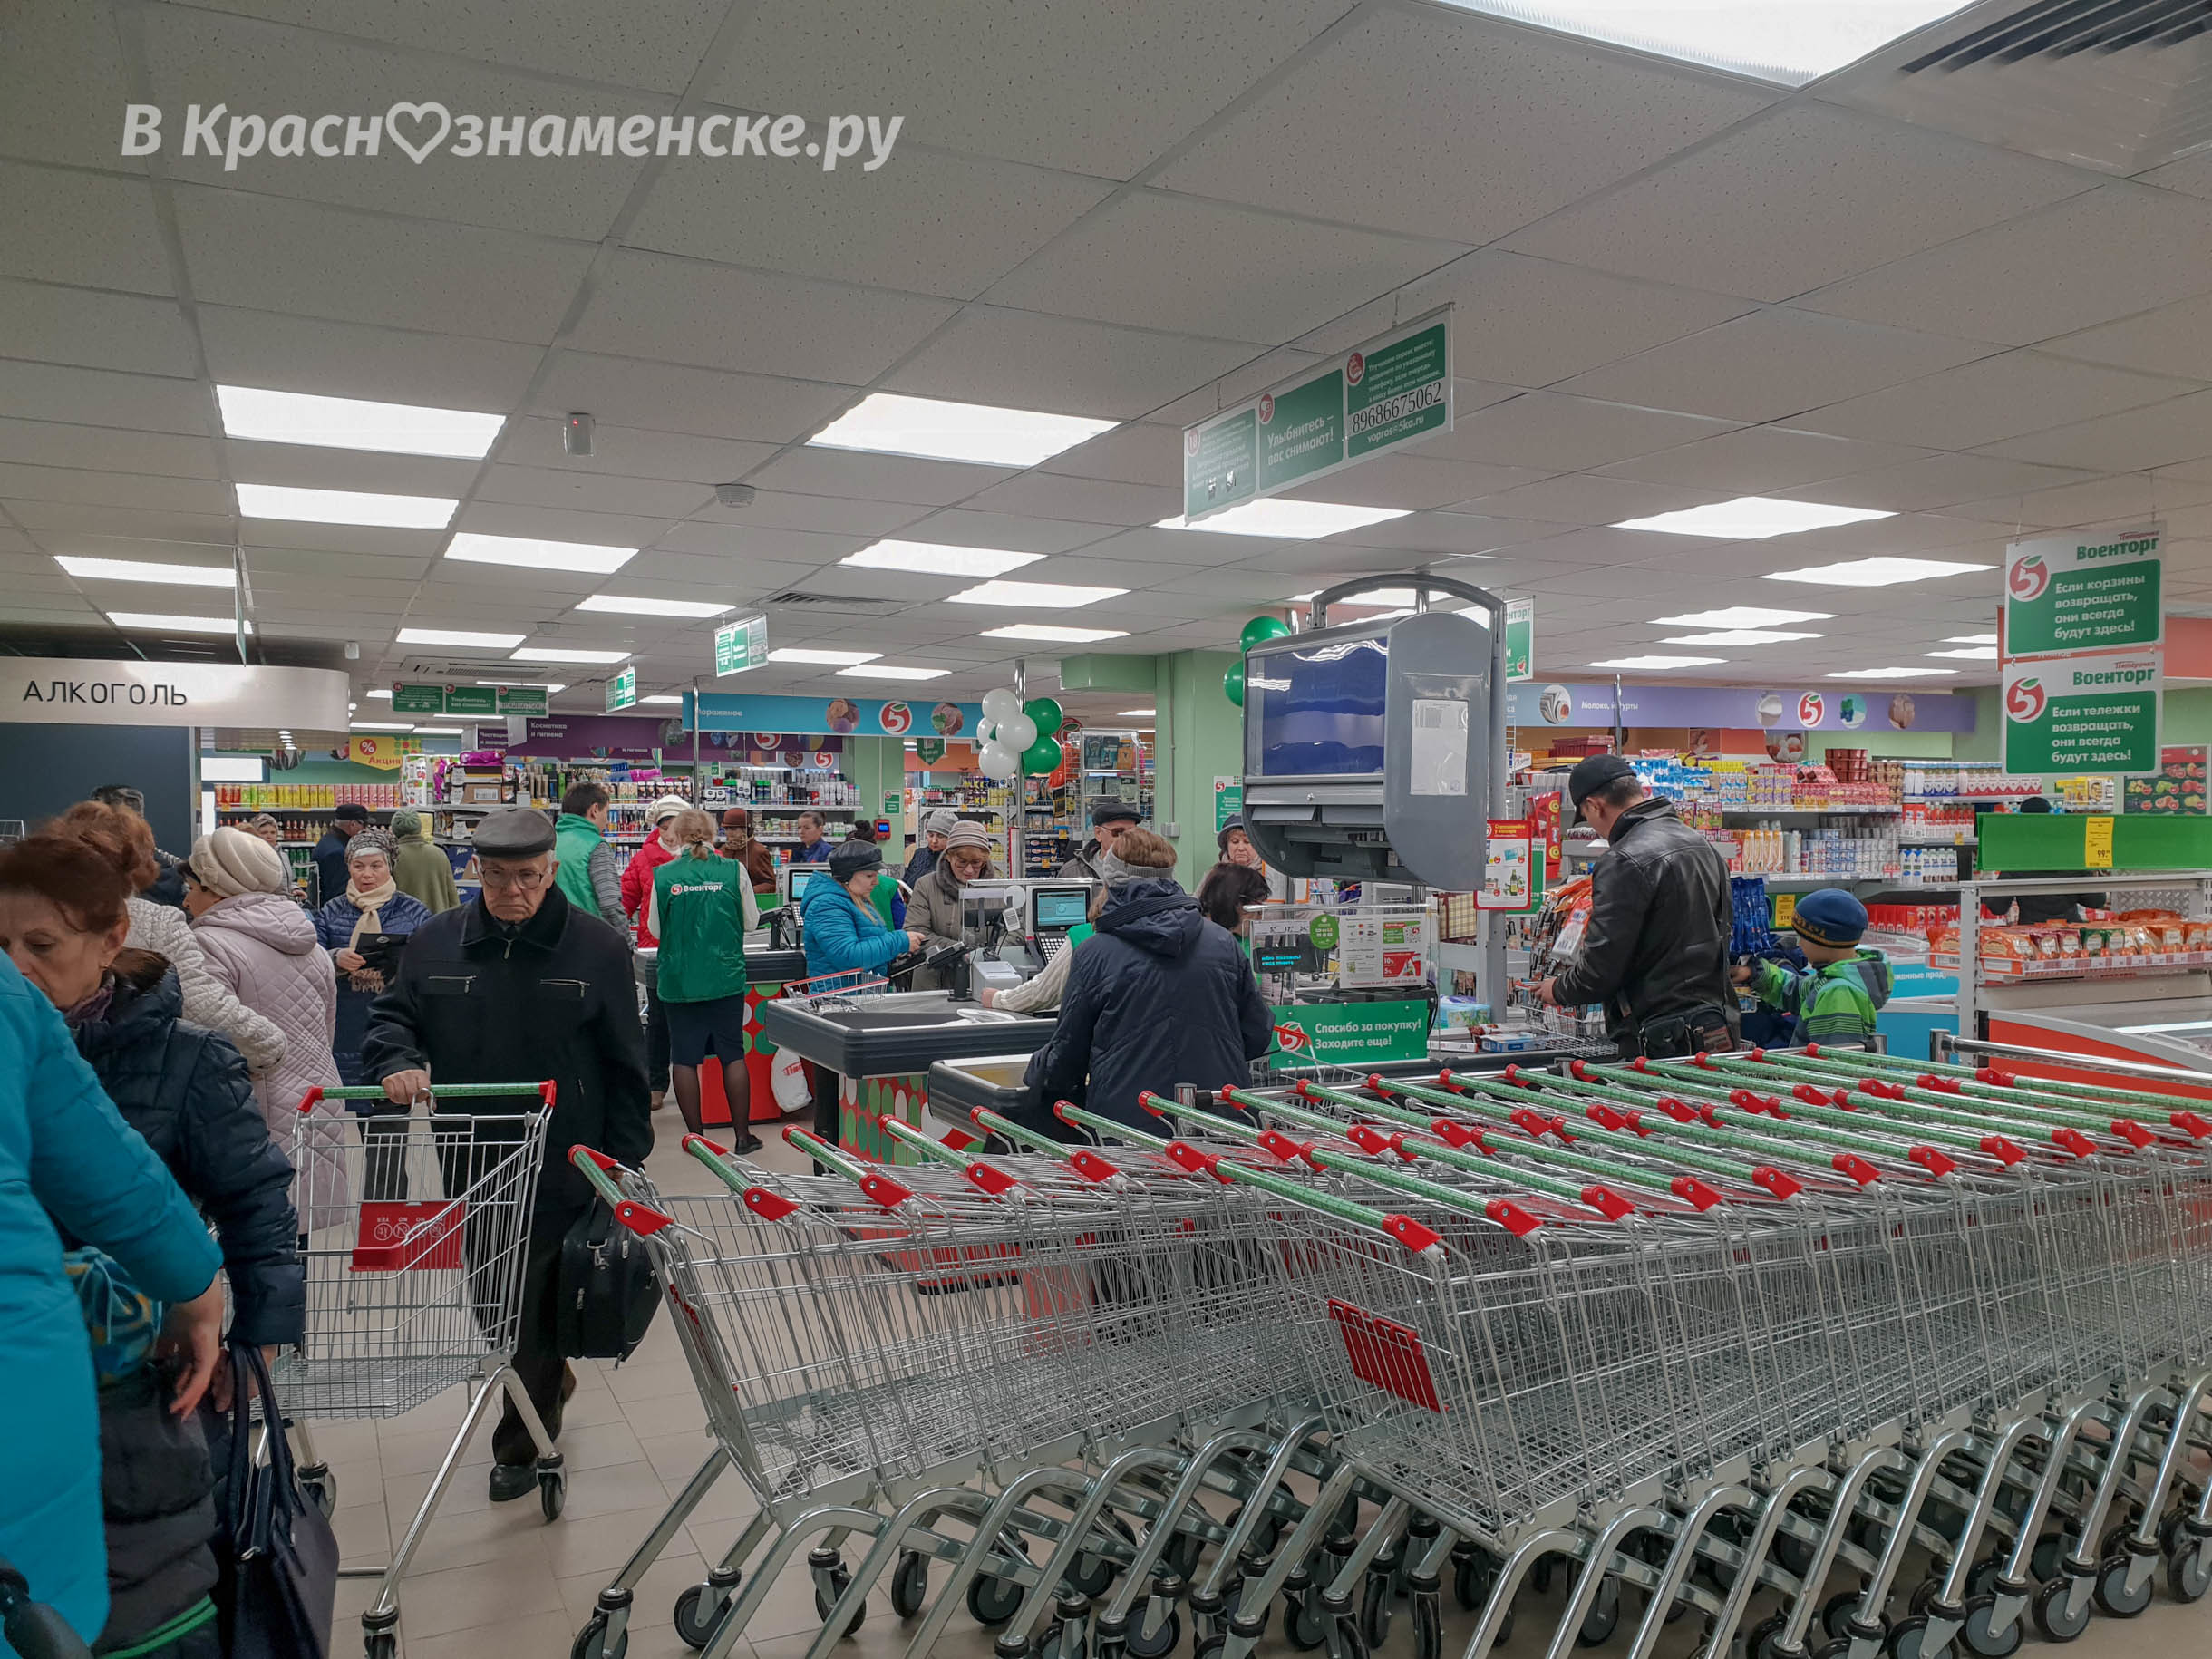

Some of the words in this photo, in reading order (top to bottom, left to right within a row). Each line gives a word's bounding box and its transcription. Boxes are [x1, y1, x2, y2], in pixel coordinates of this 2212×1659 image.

[1353, 381, 1441, 433] 89686675062
[1268, 417, 1324, 449] Улыбнитесь
[1268, 450, 1284, 466] вас
[1285, 426, 1334, 459] снимают!
[2077, 537, 2159, 560] Военторг
[2055, 581, 2083, 594] Если
[2087, 574, 2145, 592] корзины
[2054, 594, 2138, 609] возвращать,
[2054, 612, 2079, 625] они
[2081, 607, 2124, 623] всегда
[2054, 625, 2091, 640] будут
[2095, 620, 2135, 636] здесь!
[2073, 668, 2155, 685] Военторг
[23, 680, 188, 706] АЛКОГОЛЬ
[2052, 706, 2081, 718] Если
[2083, 704, 2140, 716] тележки
[2052, 721, 2134, 733] возвращать,
[2052, 735, 2075, 748] они
[2079, 735, 2120, 747] всегда
[369, 757, 401, 765] Акция
[2052, 750, 2089, 763] будут
[2091, 749, 2131, 762] здесь!
[684, 885, 723, 893] Военторг
[1315, 1022, 1359, 1034] Спасибо
[1361, 1024, 1373, 1033] за
[1375, 1019, 1421, 1032] покупку!
[1315, 1037, 1364, 1050] Заходите
[1366, 1036, 1392, 1048] еще!
